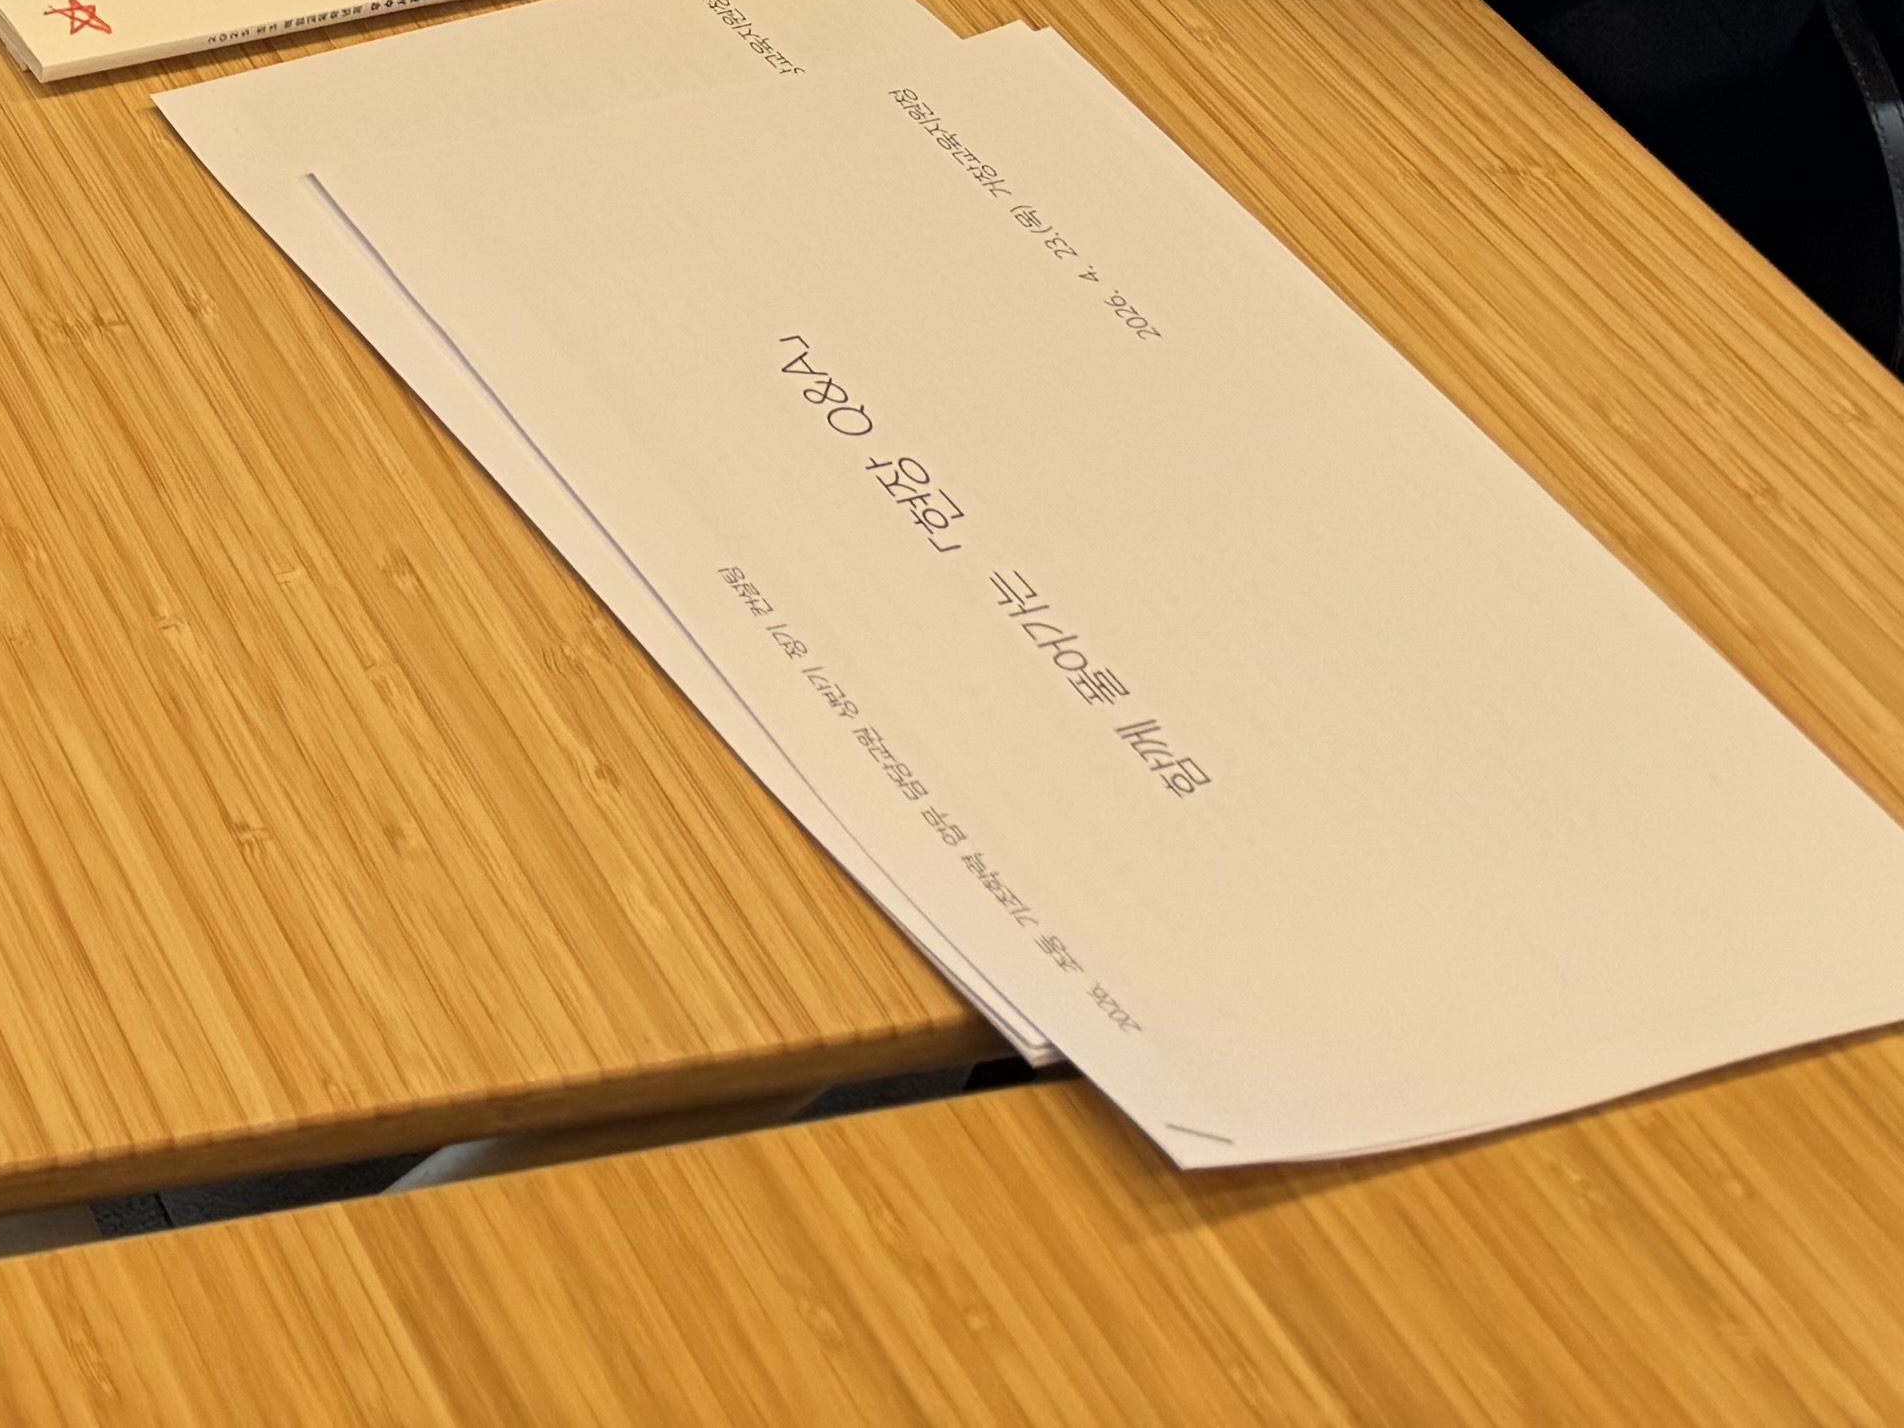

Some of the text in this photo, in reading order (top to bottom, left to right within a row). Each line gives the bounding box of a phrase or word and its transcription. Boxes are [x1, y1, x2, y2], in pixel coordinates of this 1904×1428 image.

[888, 87, 1013, 198] 거창교육지원청
[1078, 265, 1100, 284] 4.
[1103, 289, 1162, 341] 2026.
[717, 566, 774, 617] 컨설팅
[767, 624, 808, 659] 정기
[989, 570, 1130, 706] 풀어가는
[802, 667, 859, 719] 상반기
[853, 725, 929, 800] 담당교원
[1113, 719, 1212, 799] 함께
[921, 806, 968, 847] 업무
[960, 852, 1039, 927] 기초학력
[1033, 934, 1084, 973] 초등
